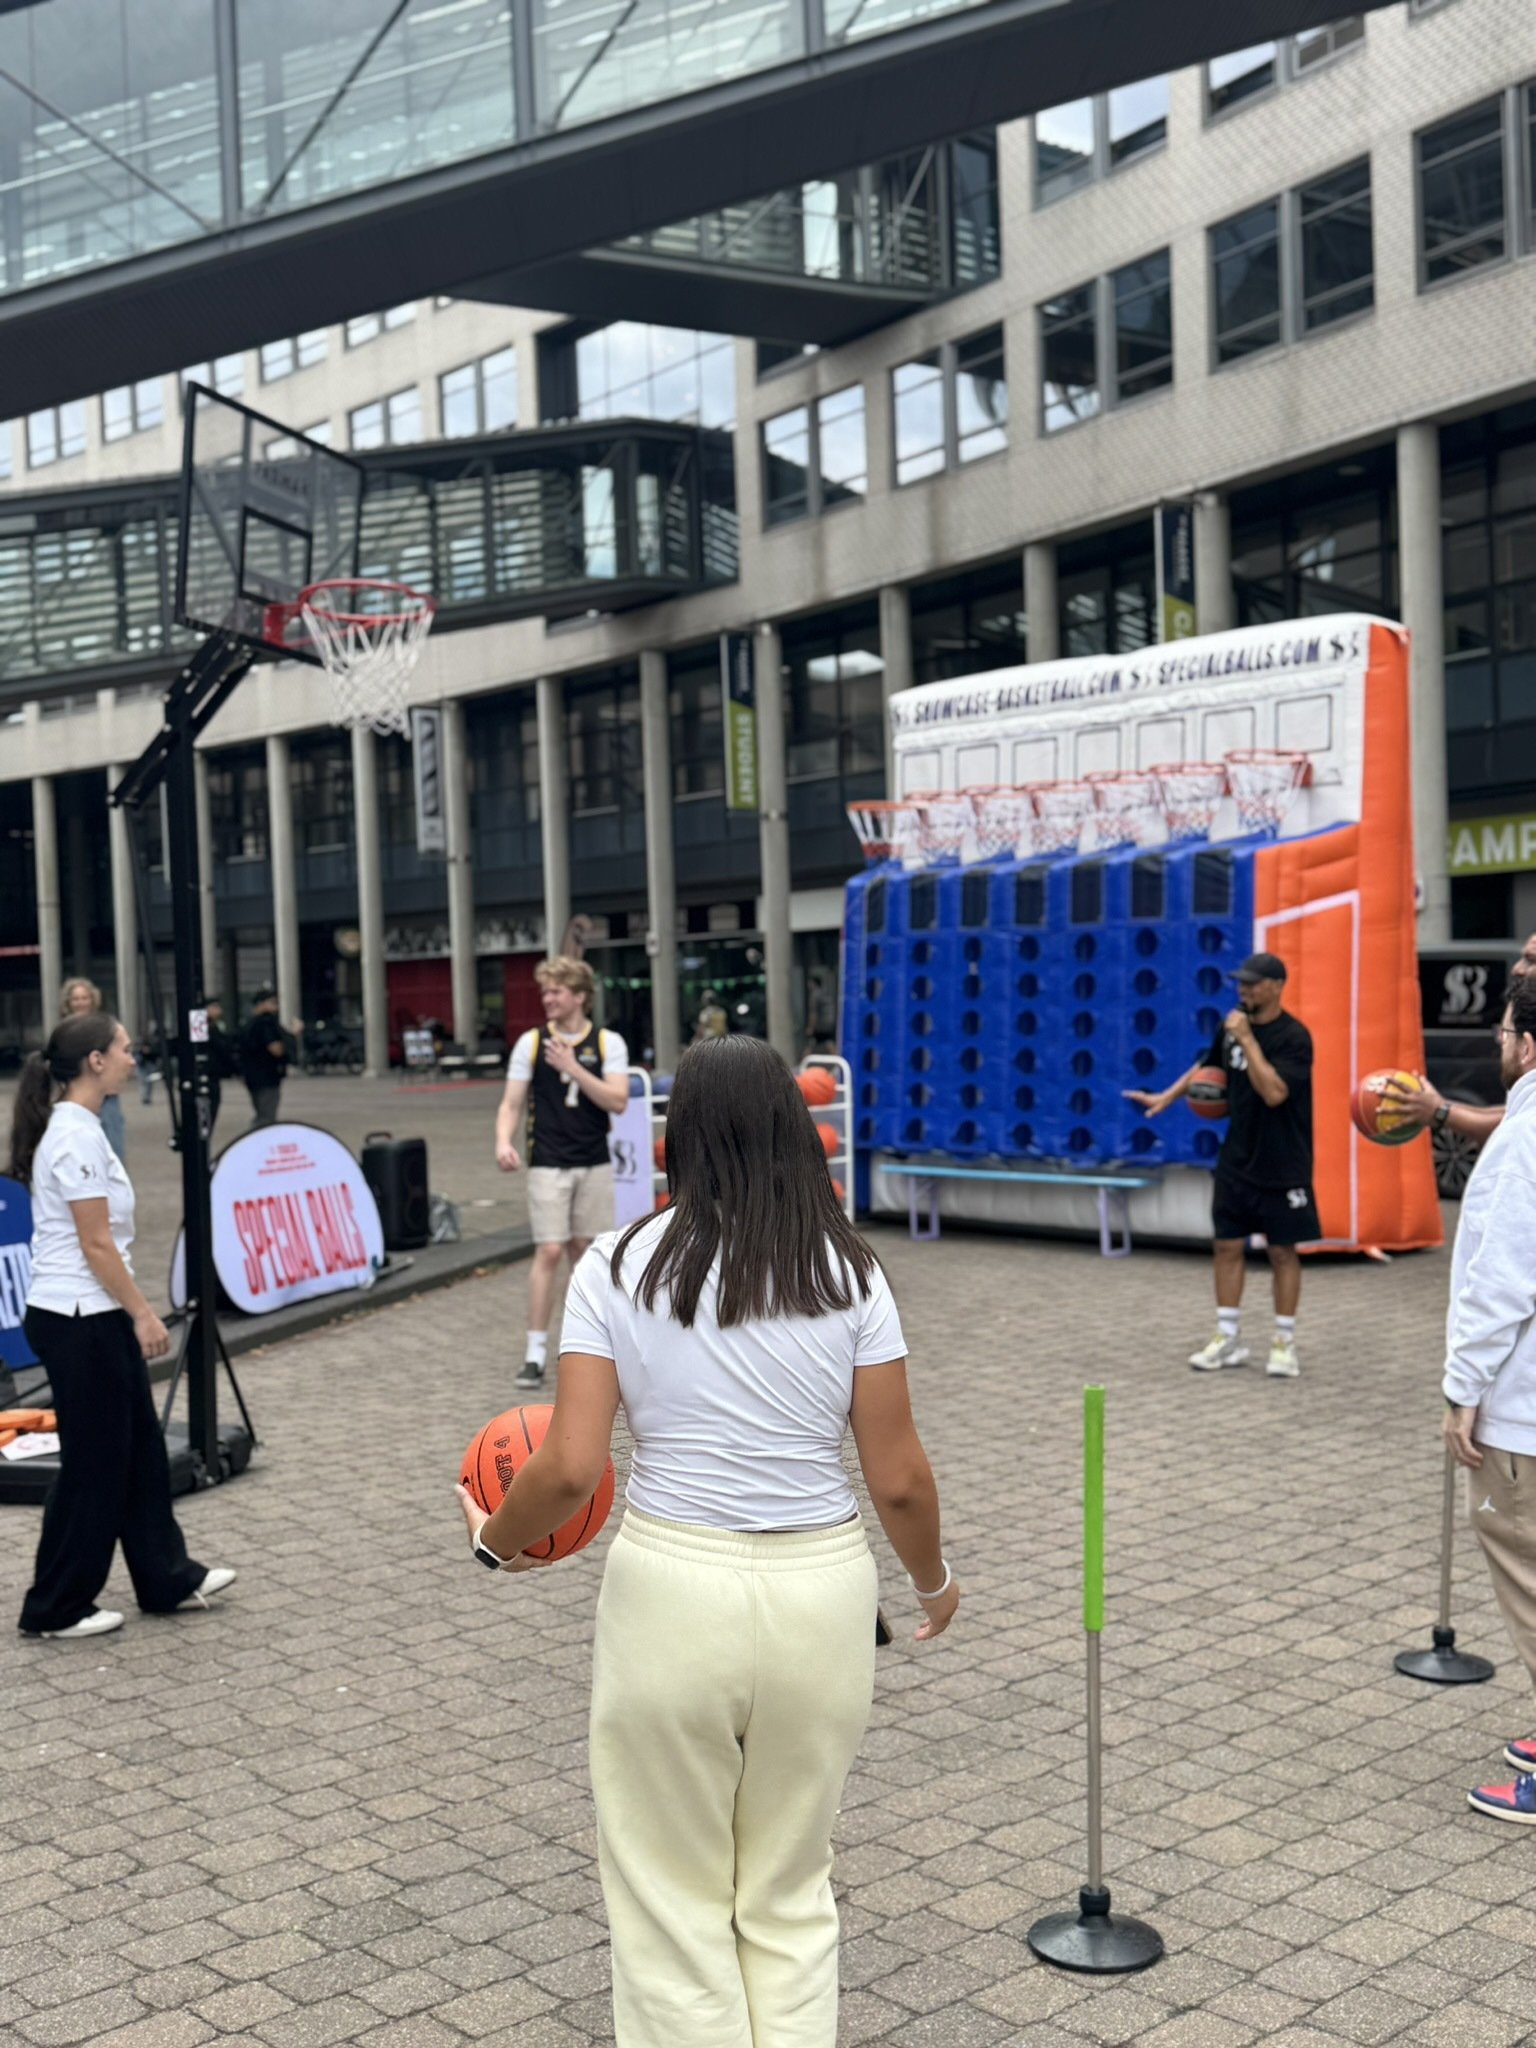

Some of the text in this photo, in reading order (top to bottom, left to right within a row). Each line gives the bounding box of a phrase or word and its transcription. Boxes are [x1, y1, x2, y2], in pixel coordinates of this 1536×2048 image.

[915, 669, 1123, 724] SHOWCASE-BASKETBALL.COM
[1159, 635, 1321, 685] SPECIALBALLS.COM
[736, 712, 754, 804] STUDENT
[1446, 820, 1536, 868] AMP
[233, 1181, 367, 1296] SPECIAL BALLS
[494, 1435, 510, 1449] 4
